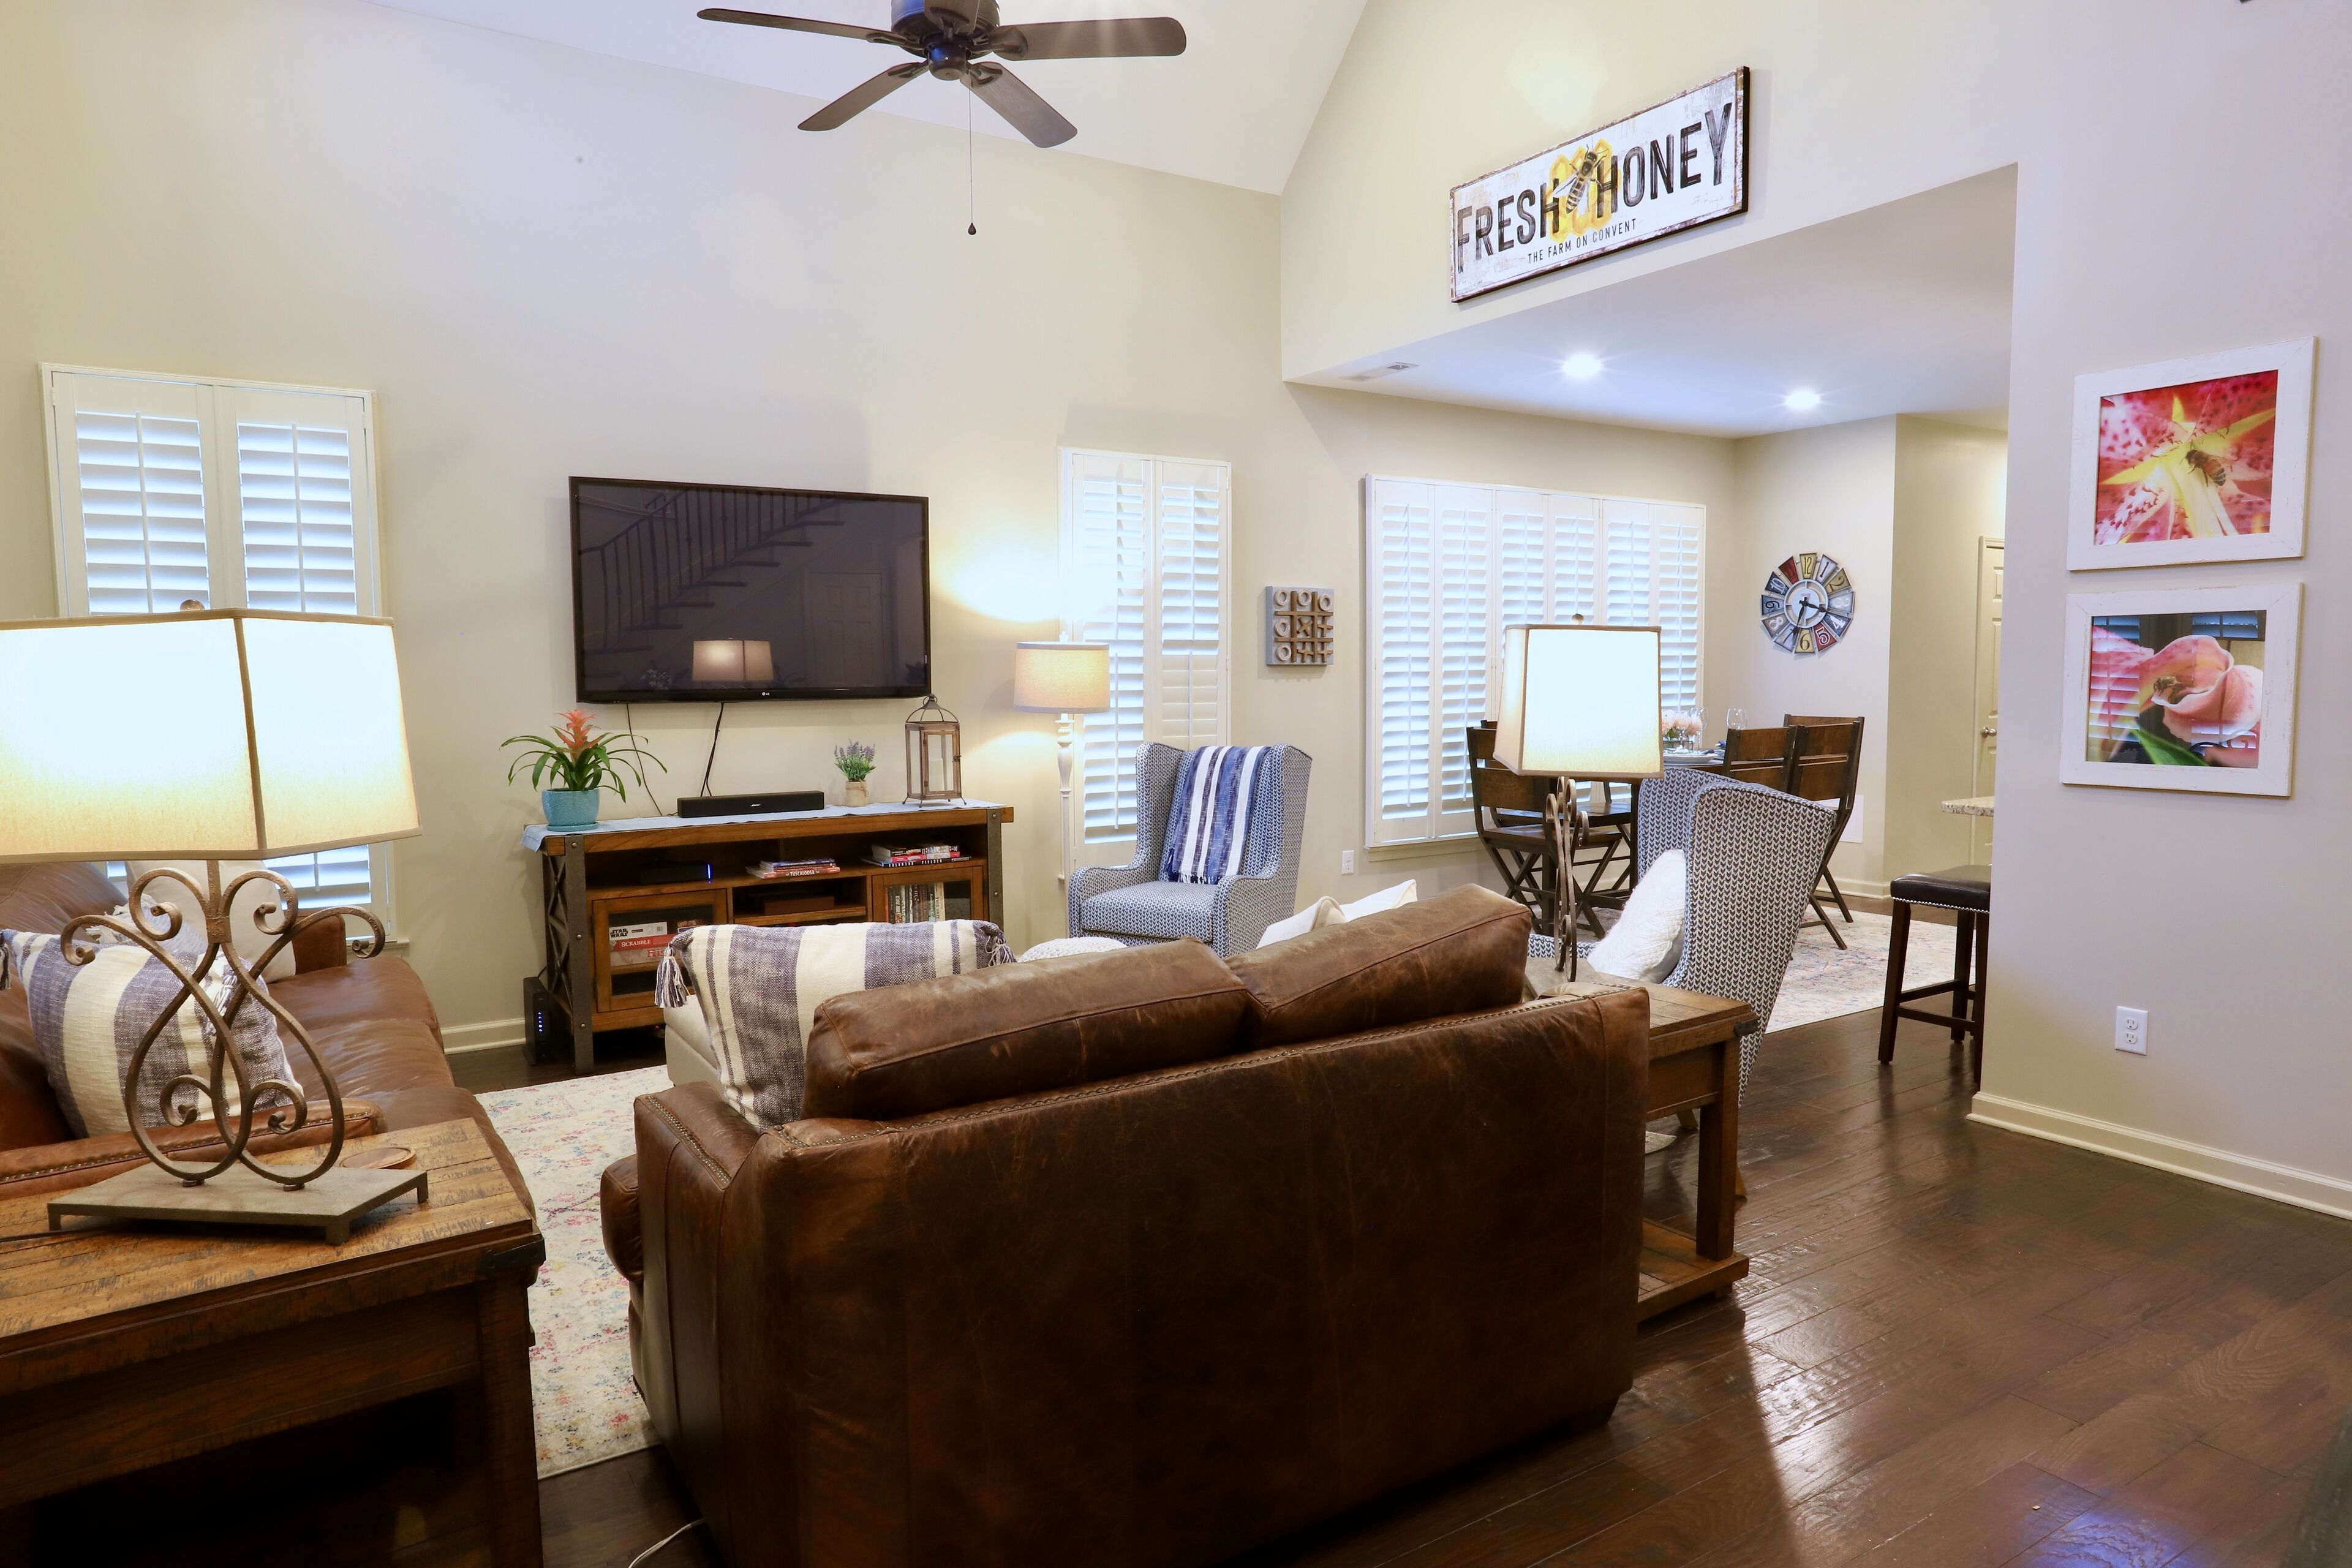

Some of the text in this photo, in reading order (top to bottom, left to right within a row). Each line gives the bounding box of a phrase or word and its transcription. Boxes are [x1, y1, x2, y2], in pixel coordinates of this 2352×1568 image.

[1457, 102, 1732, 273] FRESH HONEY
[1528, 218, 1637, 264] THE FARM ON CONVENT
[1804, 557, 1812, 575] 12
[1820, 562, 1830, 578] 1
[1771, 578, 1786, 594] 10
[1829, 576, 1845, 593] 2
[1769, 616, 1784, 631] 8
[1830, 614, 1845, 630] 4
[1800, 633, 1810, 650] 6
[1815, 627, 1830, 645] 5
